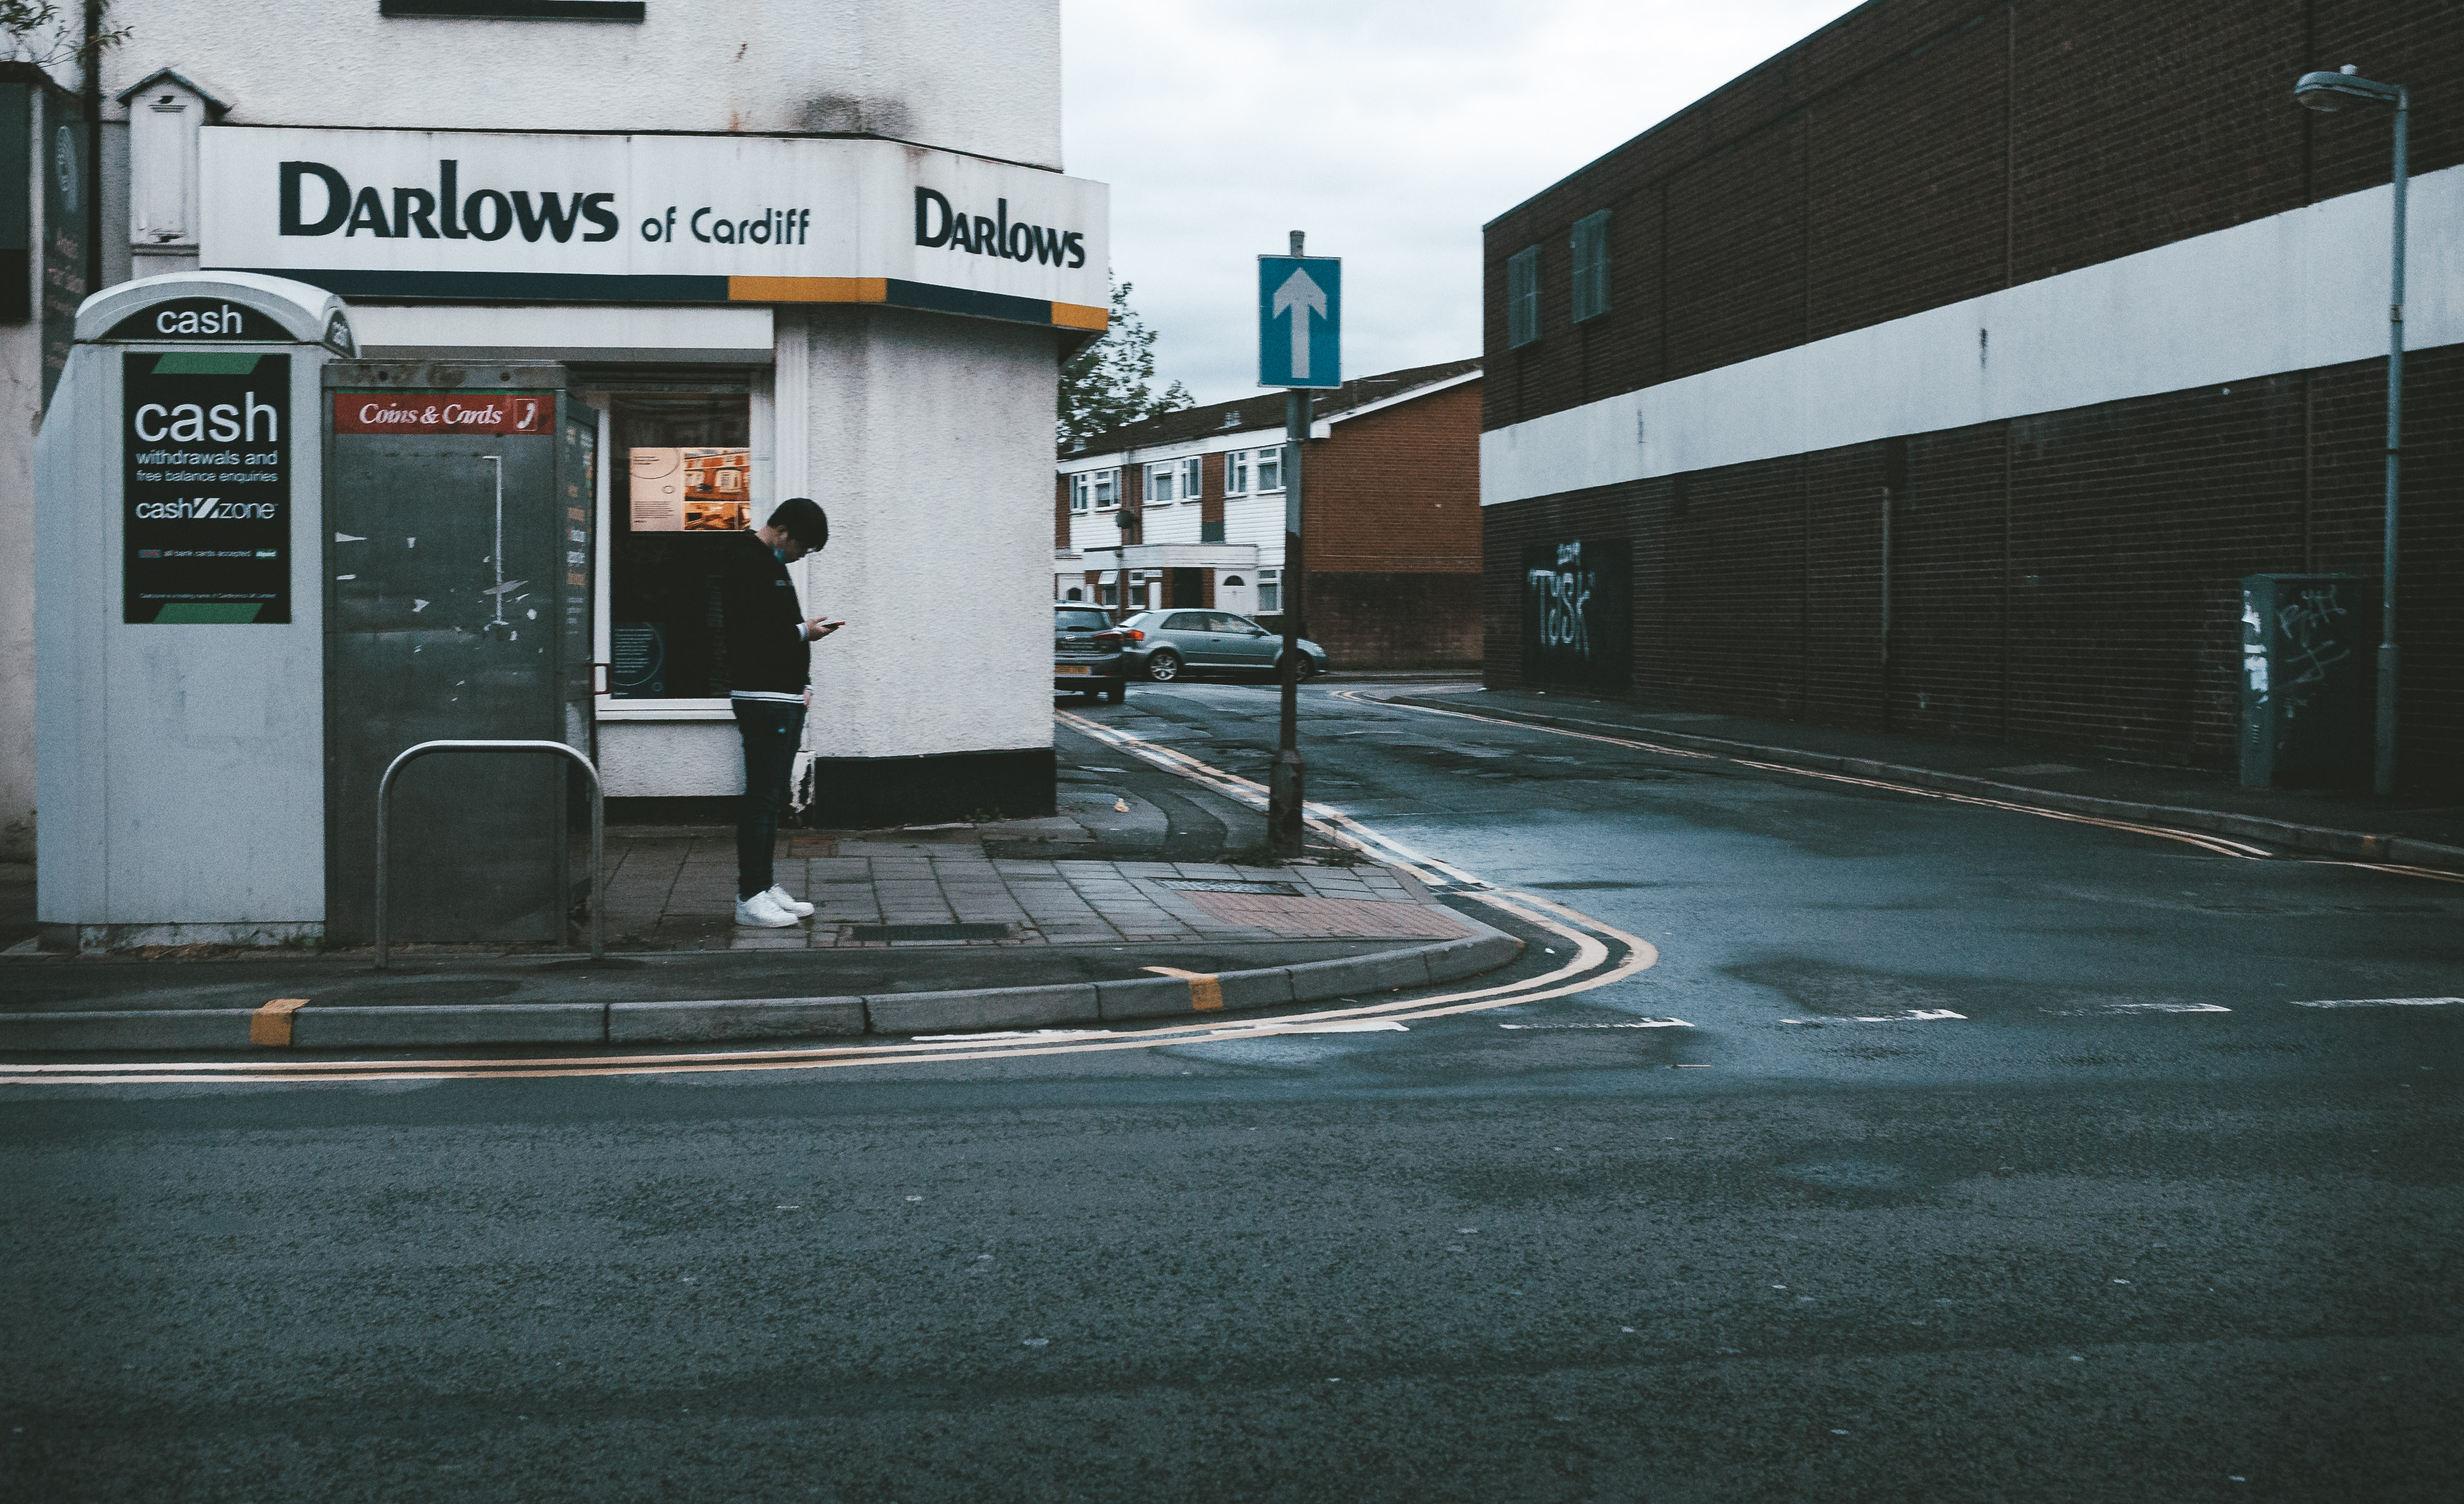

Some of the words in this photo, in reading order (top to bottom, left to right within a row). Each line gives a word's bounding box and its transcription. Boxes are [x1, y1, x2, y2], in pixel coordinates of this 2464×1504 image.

[641, 206, 677, 243] of
[690, 206, 811, 245] Cardiff
[156, 304, 242, 333] cash
[134, 391, 278, 442] cash
[359, 402, 418, 424] Coins
[420, 406, 440, 424] &
[442, 404, 503, 424] Cards
[135, 449, 241, 465] withdrawals
[244, 450, 278, 465] and
[136, 470, 162, 482] free
[165, 470, 217, 482] balance
[219, 470, 279, 484] enquiries
